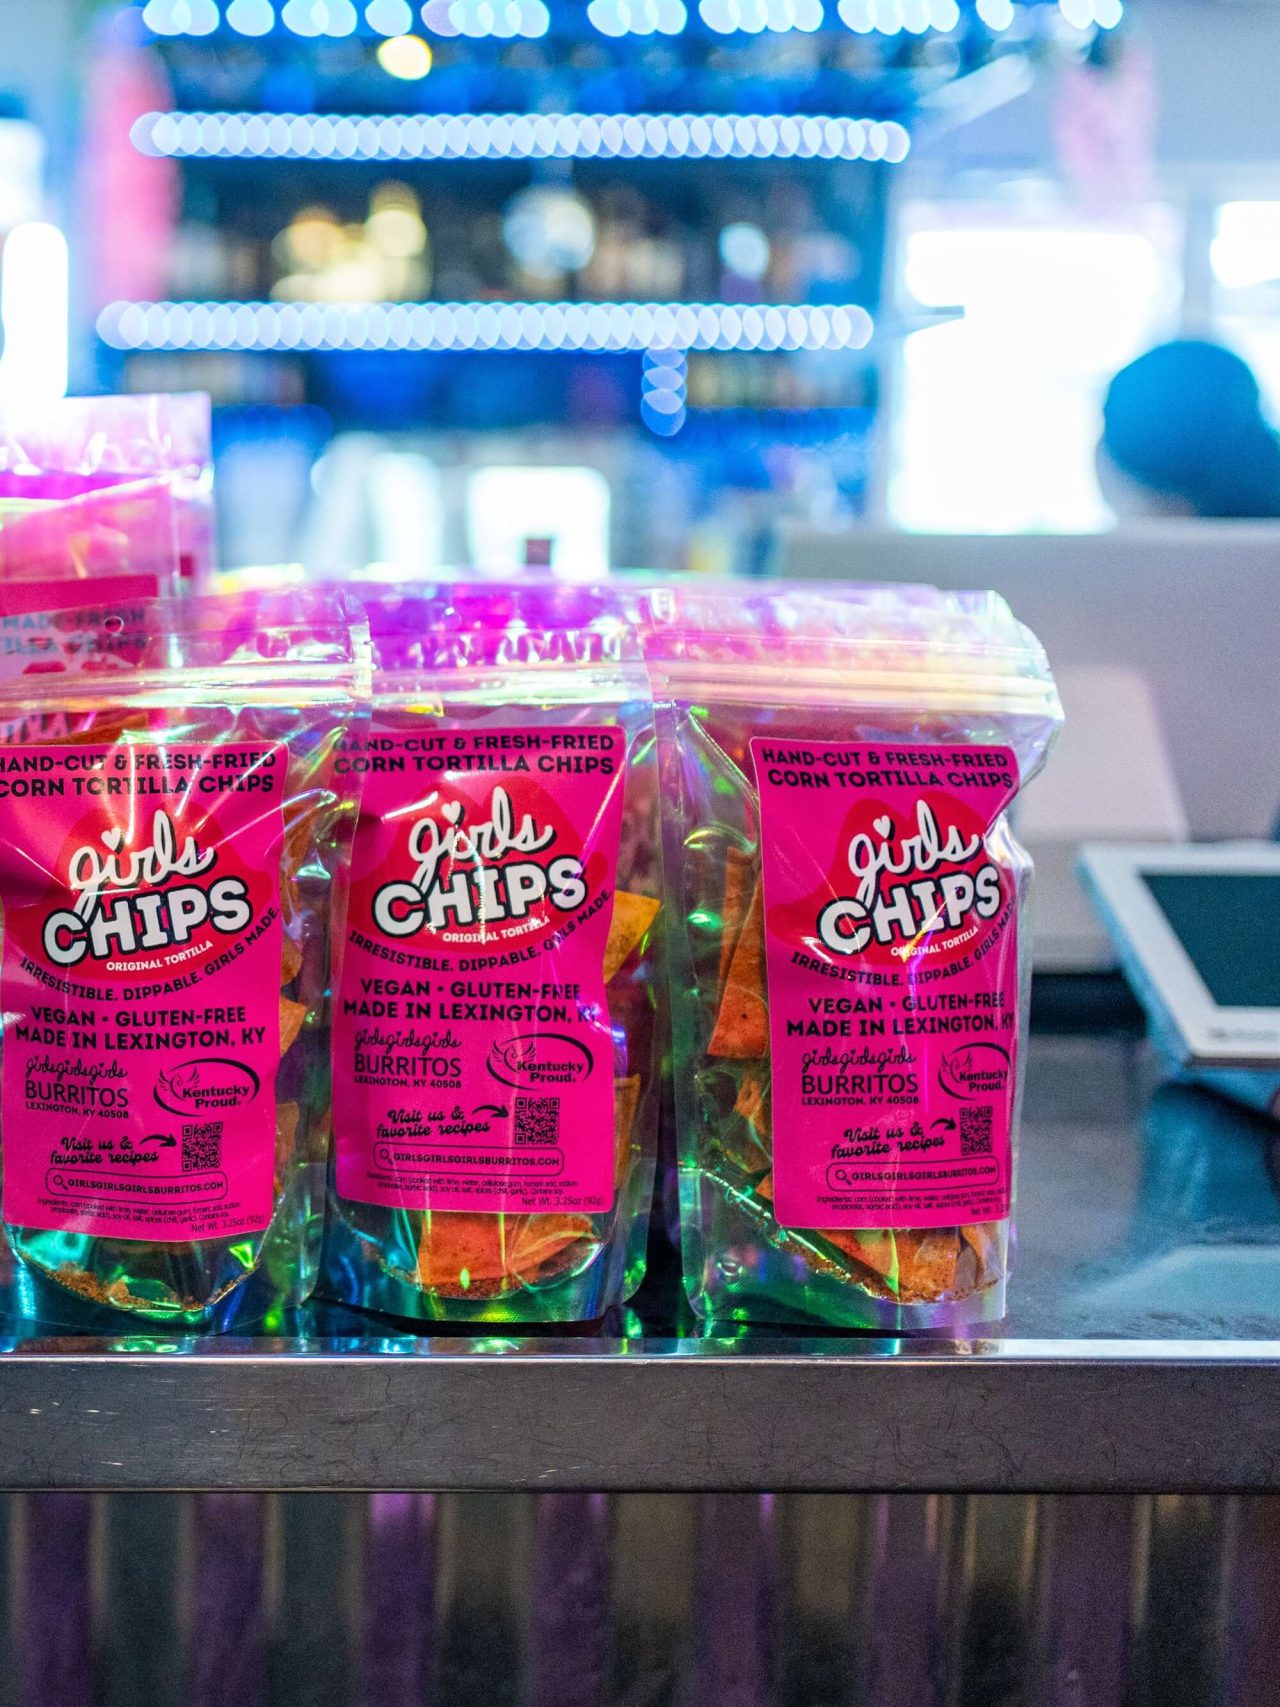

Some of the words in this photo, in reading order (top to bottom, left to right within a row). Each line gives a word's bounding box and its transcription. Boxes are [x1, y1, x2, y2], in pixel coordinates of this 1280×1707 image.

[333, 737, 446, 751] HAND-CUT
[453, 735, 466, 750] &
[473, 734, 614, 751] FRESH-FRIED
[114, 753, 127, 770] &
[136, 751, 276, 770] FRESH-FRIED
[334, 756, 404, 774] CORN
[413, 755, 530, 772] TORTILLA
[537, 756, 614, 774] CHIPS
[762, 748, 862, 767] HAND-CUT
[868, 752, 880, 765] &
[886, 752, 1008, 768] FRESH-FRIED
[72, 776, 191, 796] TORTILLA
[198, 775, 275, 793] CHIPS
[768, 768, 830, 788] CORN
[835, 769, 943, 788] TORTILLA
[947, 770, 1013, 789] CHIPS
[408, 786, 556, 894] girls
[848, 799, 982, 908] girls
[68, 809, 218, 922] girls
[373, 854, 588, 938] CHIPS
[817, 862, 1001, 955] CHIPS
[41, 877, 252, 968] CHIPS
[442, 931, 499, 943] ORIGINAL
[500, 916, 550, 940] TORTILLA
[942, 925, 979, 951] TORTILLA
[20, 957, 118, 1001] IRRESISTIBLE.
[123, 973, 204, 1001] DIPPABLE.
[204, 943, 245, 976] GIRLS
[245, 906, 281, 946] MADE.
[106, 958, 163, 971] ORIGINAL
[164, 940, 213, 966] TORTILLA
[348, 930, 453, 972] IRRESISTIBLE.
[459, 945, 541, 972] DIPPABLE.
[790, 951, 903, 986] IRRESISTIBLE.
[973, 930, 1000, 960] GIRLS
[360, 978, 430, 996] VEGAN
[450, 981, 580, 1000] GLUTEN-FREE
[344, 999, 398, 1019] MADE
[405, 1002, 431, 1020] IN
[439, 1004, 572, 1024] LEXINGTON,
[808, 997, 883, 1014] VEGAN
[902, 992, 1005, 1012] GLUTEN-FREE
[31, 1006, 96, 1026] VEGAN
[115, 1006, 247, 1027] GLUTEN-FREE
[787, 1019, 851, 1036] MADE
[859, 1019, 885, 1036] IN
[893, 1015, 998, 1036] LEXINGTON,
[1001, 1012, 1014, 1030] KY
[15, 1025, 66, 1047] MADE
[72, 1032, 97, 1049] IN
[105, 1030, 236, 1050] LEXINGTON,
[242, 1027, 266, 1045] KY
[354, 1053, 462, 1078] BURRITOS
[517, 1060, 584, 1074] Kentucky
[959, 1070, 1009, 1082] Kentucky
[25, 1080, 129, 1108] BURRITOS
[182, 1084, 251, 1098] Kentucky
[413, 1079, 427, 1088] KY
[430, 1079, 462, 1089] 40508
[801, 1073, 918, 1095] BURRITOS
[870, 1095, 883, 1105] KY
[886, 1095, 919, 1105] 40508
[98, 1110, 129, 1119] 40508
[387, 1108, 423, 1124] Visit
[427, 1111, 445, 1123] us
[377, 1123, 432, 1140] favorite
[438, 1120, 490, 1137] recipes
[843, 1128, 879, 1143] Visit
[885, 1127, 903, 1139] us
[61, 1136, 92, 1151] Visit
[98, 1140, 115, 1151] us
[830, 1143, 890, 1160] favorite
[896, 1136, 945, 1153] recipes
[50, 1151, 102, 1165] favorite
[108, 1151, 159, 1166] recipes
